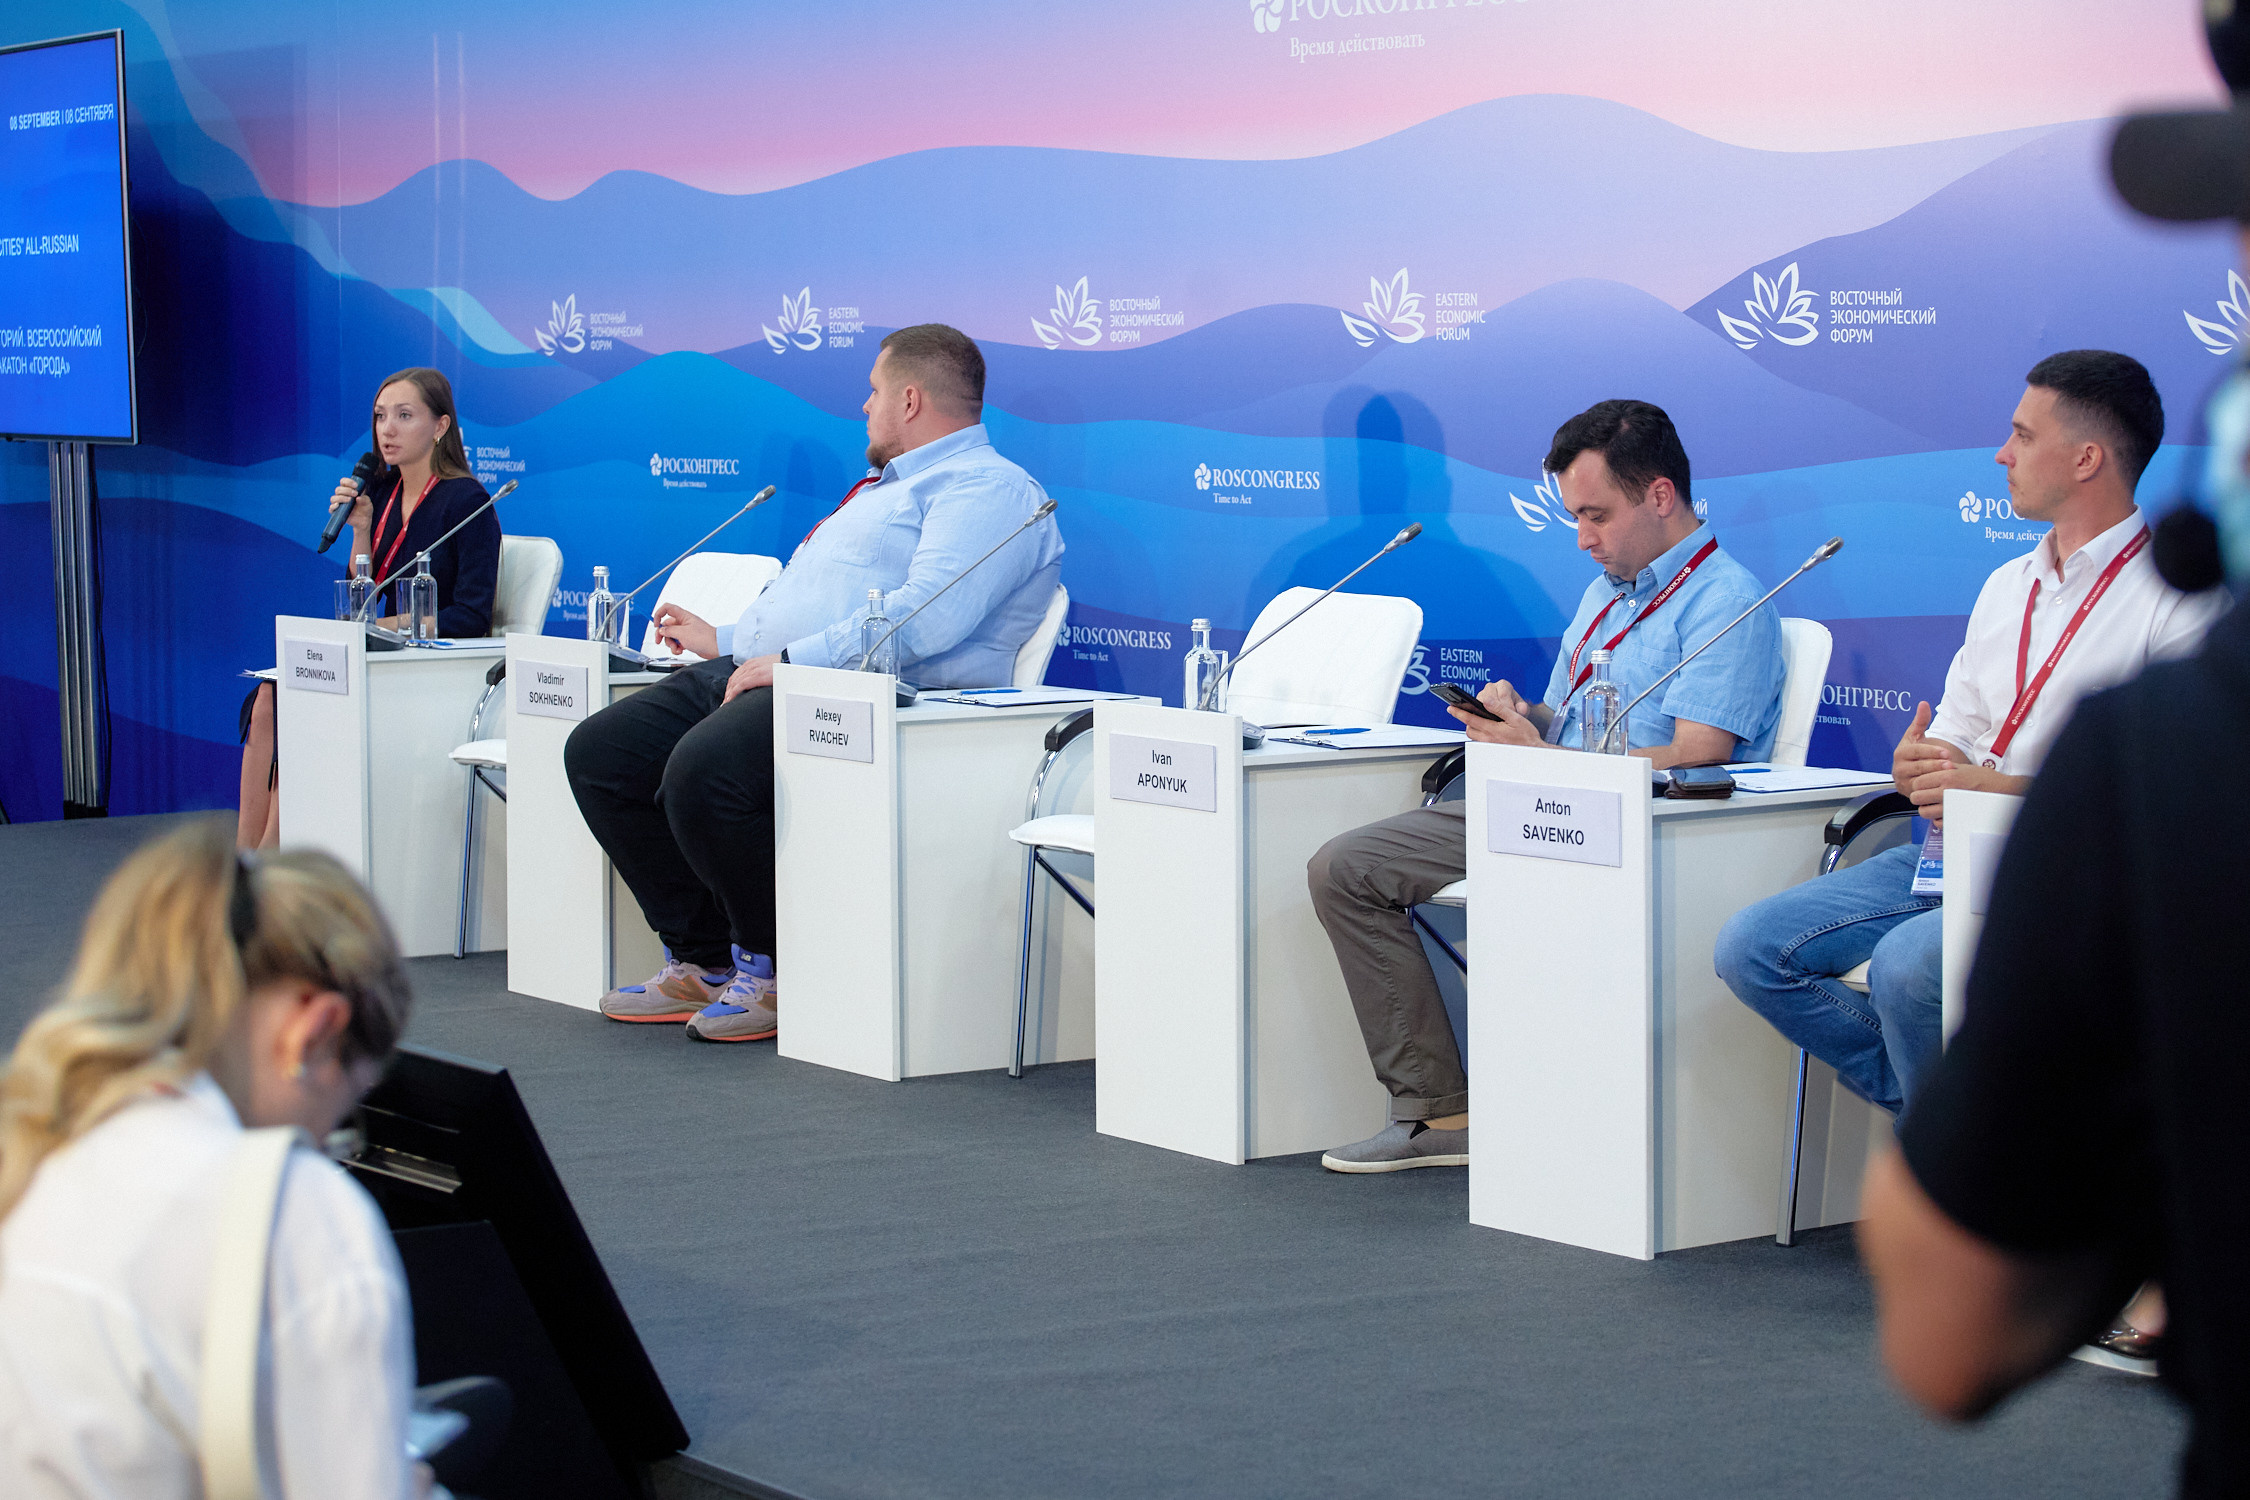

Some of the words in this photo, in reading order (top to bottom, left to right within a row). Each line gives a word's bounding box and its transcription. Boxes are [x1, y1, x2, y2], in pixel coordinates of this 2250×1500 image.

[1289, 37, 1335, 63] Время
[1338, 33, 1425, 56] действовать
[9, 116, 18, 131] 08
[18, 110, 61, 130] SEPTEMBER
[65, 108, 74, 125] 08
[75, 103, 114, 123] СЕНТЯБРЯ
[25, 233, 80, 255] ALL-RUSSIAN
[1109, 295, 1161, 312] ВОСТОЧНЫЙ
[1435, 292, 1478, 306] EASTERN
[1830, 287, 1903, 306] ВОСТОЧНЫЙ
[828, 306, 860, 319] EASTERN
[1109, 311, 1185, 327] ЭКОНОМИЧЕСКИЙ
[1435, 309, 1487, 323] ECONOMIC
[1830, 306, 1937, 325] ЭКОНОМИЧЕСКИЙ
[828, 321, 865, 334] ECONOMIC
[1435, 327, 1470, 341] FORUM
[1830, 328, 1873, 343] ФОРУМ
[27, 325, 102, 348] ВСЕРОССИЙСКИЙ
[828, 336, 854, 348] FORUM
[1109, 330, 1141, 343] ФОРУМ
[29, 356, 71, 378] «ГОРОДА»
[662, 457, 740, 475] РОСКОНГРЕСС
[1212, 468, 1321, 490] ROSCONGRESS
[1212, 492, 1231, 504] Time
[1231, 495, 1239, 504] to
[1239, 494, 1252, 505] Act
[1984, 526, 2015, 543] Время
[1072, 625, 1172, 650] ROSCONGRESS
[307, 649, 323, 661] Elena
[1440, 647, 1483, 664] EASTERN
[295, 666, 336, 682] BRONNIKOVA
[536, 671, 565, 686] Vladimir
[1440, 664, 1491, 682] ECONOMIC
[529, 691, 573, 708] SOKHNENKO
[1819, 684, 1912, 712] ОНГРЕСС
[815, 707, 842, 726] Alexey
[1815, 715, 1851, 726] твовать
[809, 729, 849, 746] RVACHEV
[1152, 749, 1172, 766] Ivan
[1137, 772, 1188, 794] APONYUK
[1535, 797, 1572, 816] Anton
[1522, 823, 1585, 846] SAVENKO
